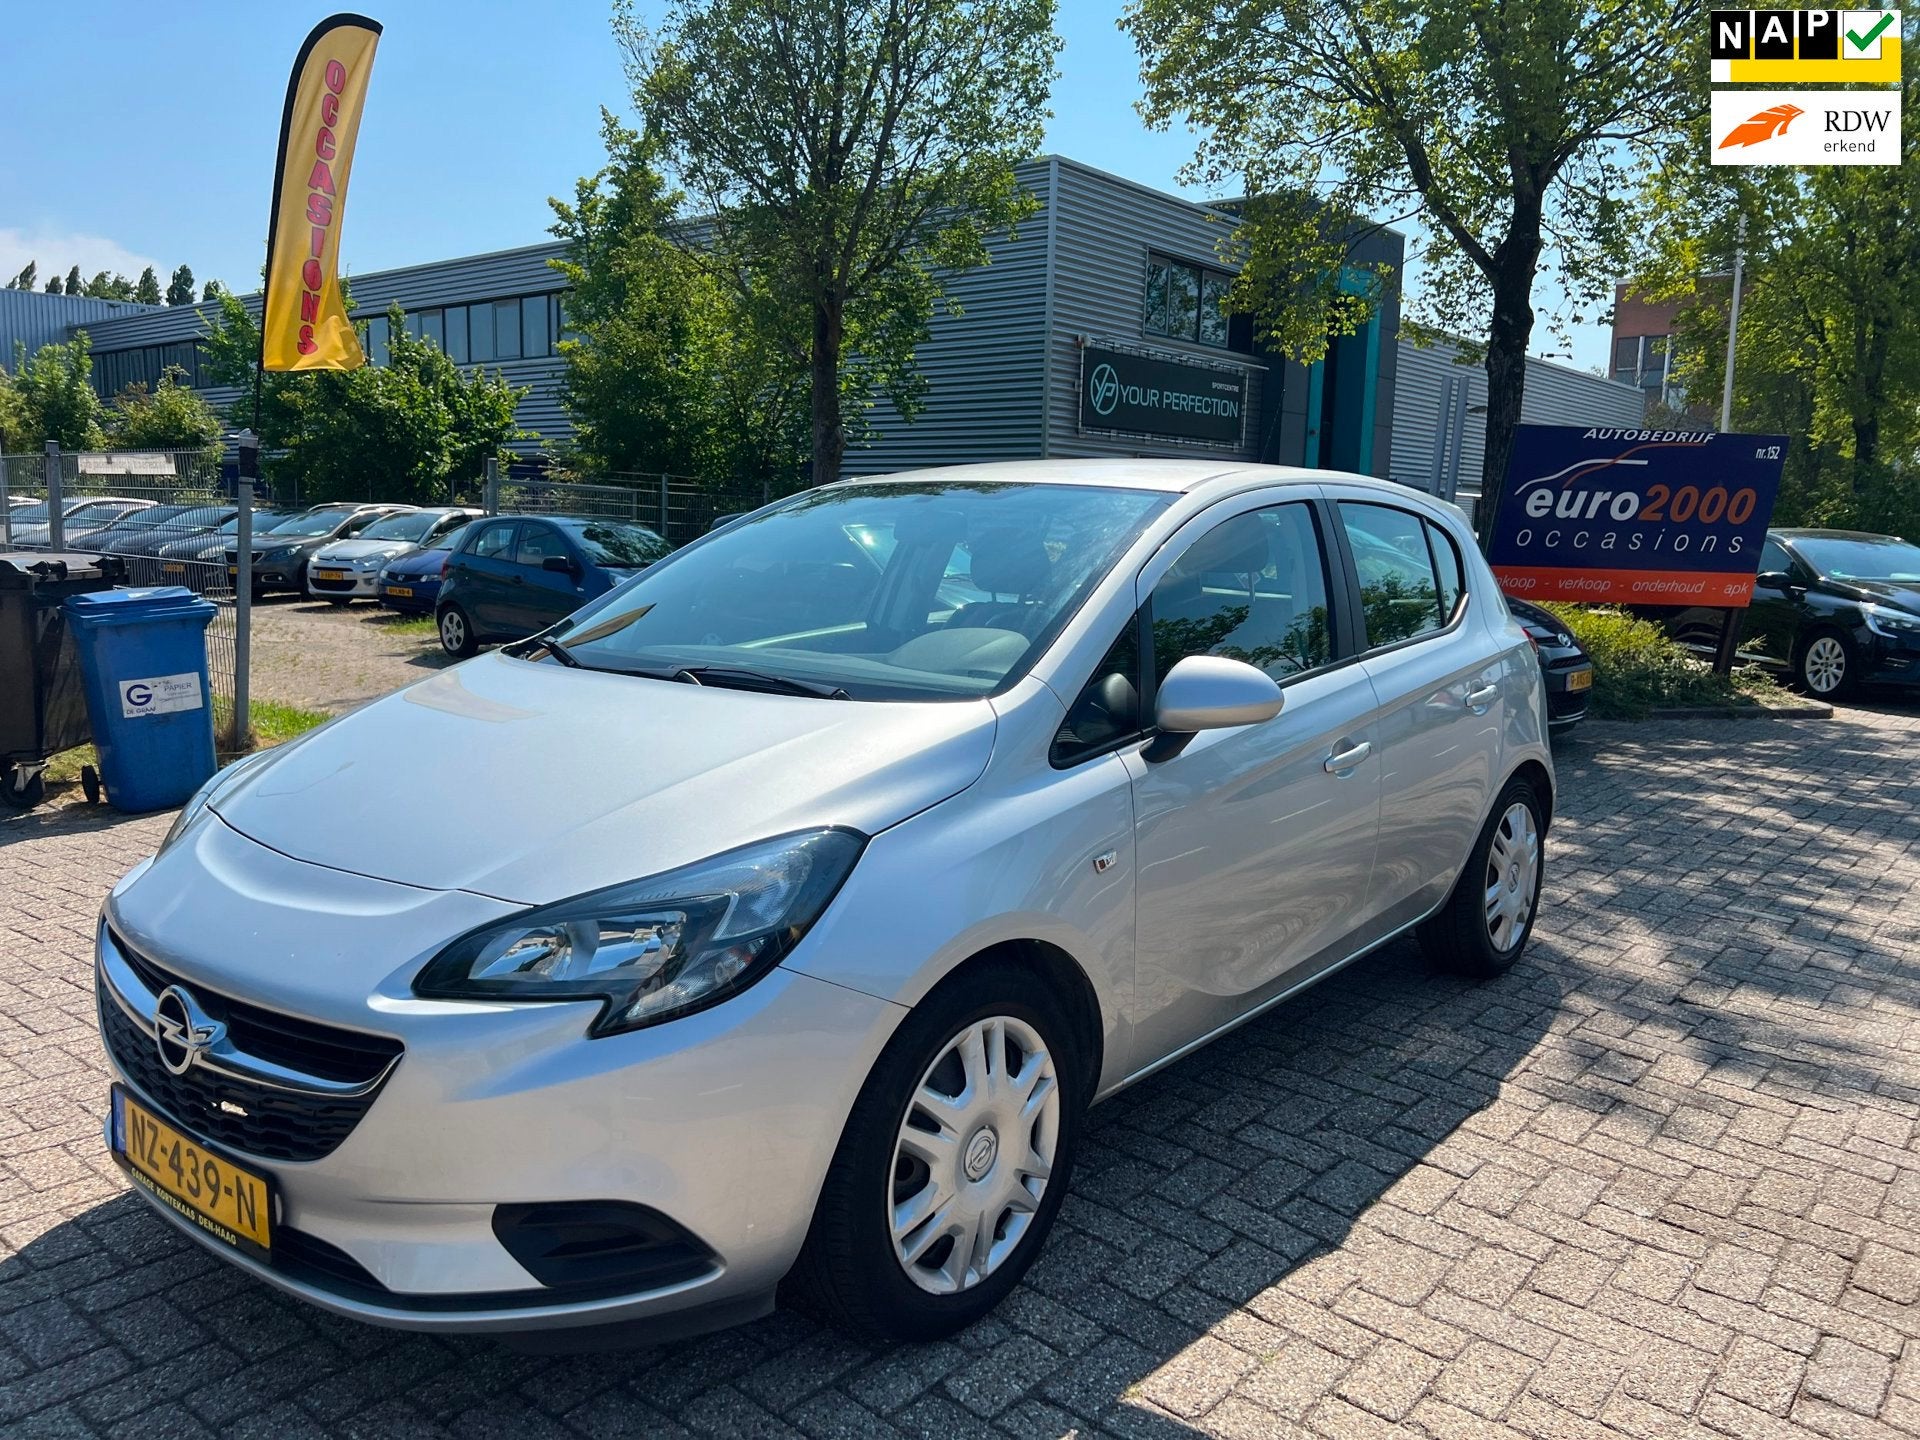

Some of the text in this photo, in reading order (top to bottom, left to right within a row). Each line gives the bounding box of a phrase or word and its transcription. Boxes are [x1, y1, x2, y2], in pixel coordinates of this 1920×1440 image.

[297, 59, 347, 356] OCCASIONS
[1120, 384, 1239, 418] YOUR PERFECTION
[1211, 381, 1239, 392] SPORTCENTRE
[1583, 428, 1716, 444] AUTOBEDRIJF
[1755, 445, 1781, 461] nr.152
[1525, 484, 1757, 525] euro2000
[1516, 528, 1744, 554] occasions
[1558, 576, 1611, 592] verkoop
[1632, 580, 1706, 594] onderhoud
[1724, 582, 1748, 597] apk
[131, 1108, 257, 1232] NZ-439-N
[131, 1167, 237, 1246] GARAGE KORTEKAAS DEN-HAAG
